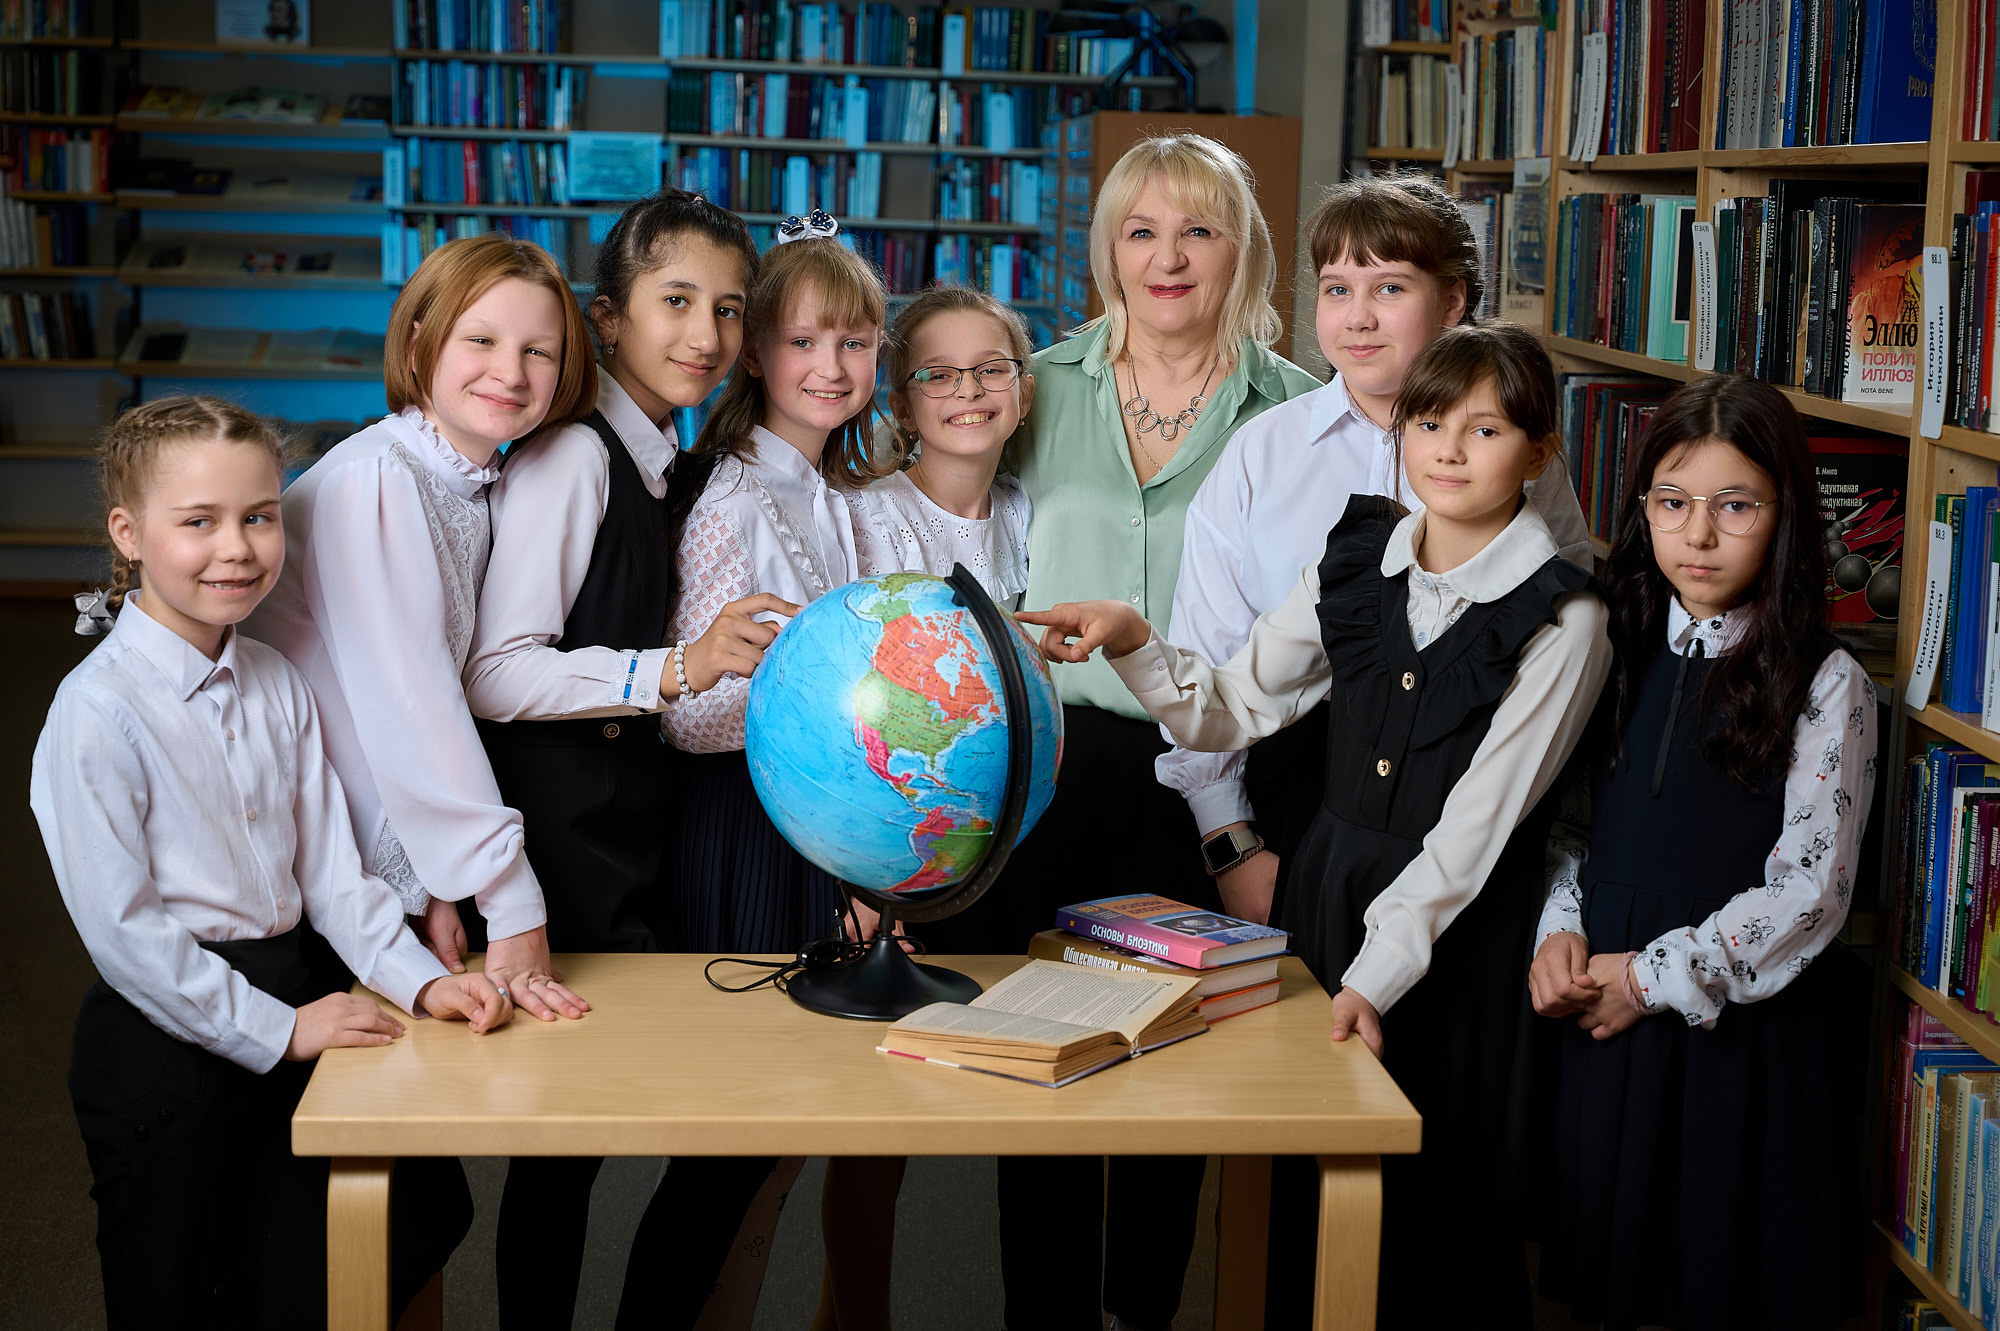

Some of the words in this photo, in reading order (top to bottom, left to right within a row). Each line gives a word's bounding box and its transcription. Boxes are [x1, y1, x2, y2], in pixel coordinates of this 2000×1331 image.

[1907, 75, 1928, 98] PRO
[1931, 254, 1942, 264] 88.1
[1927, 321, 1935, 390] История
[1936, 305, 1944, 404] психологии
[1971, 327, 1981, 409] ПСИХОЛОГИИ
[1816, 467, 1820, 475] В.
[1936, 528, 1945, 540] 88.3
[1916, 580, 1936, 675] Психология
[1927, 593, 1943, 670] личности
[1948, 807, 1958, 895] Современный
[1091, 924, 1125, 944] ОСНОВЫ
[1127, 934, 1169, 957] БИОЭТИКИ
[1949, 1165, 1958, 1249] ПРАКТИЧЕСКОЙ
